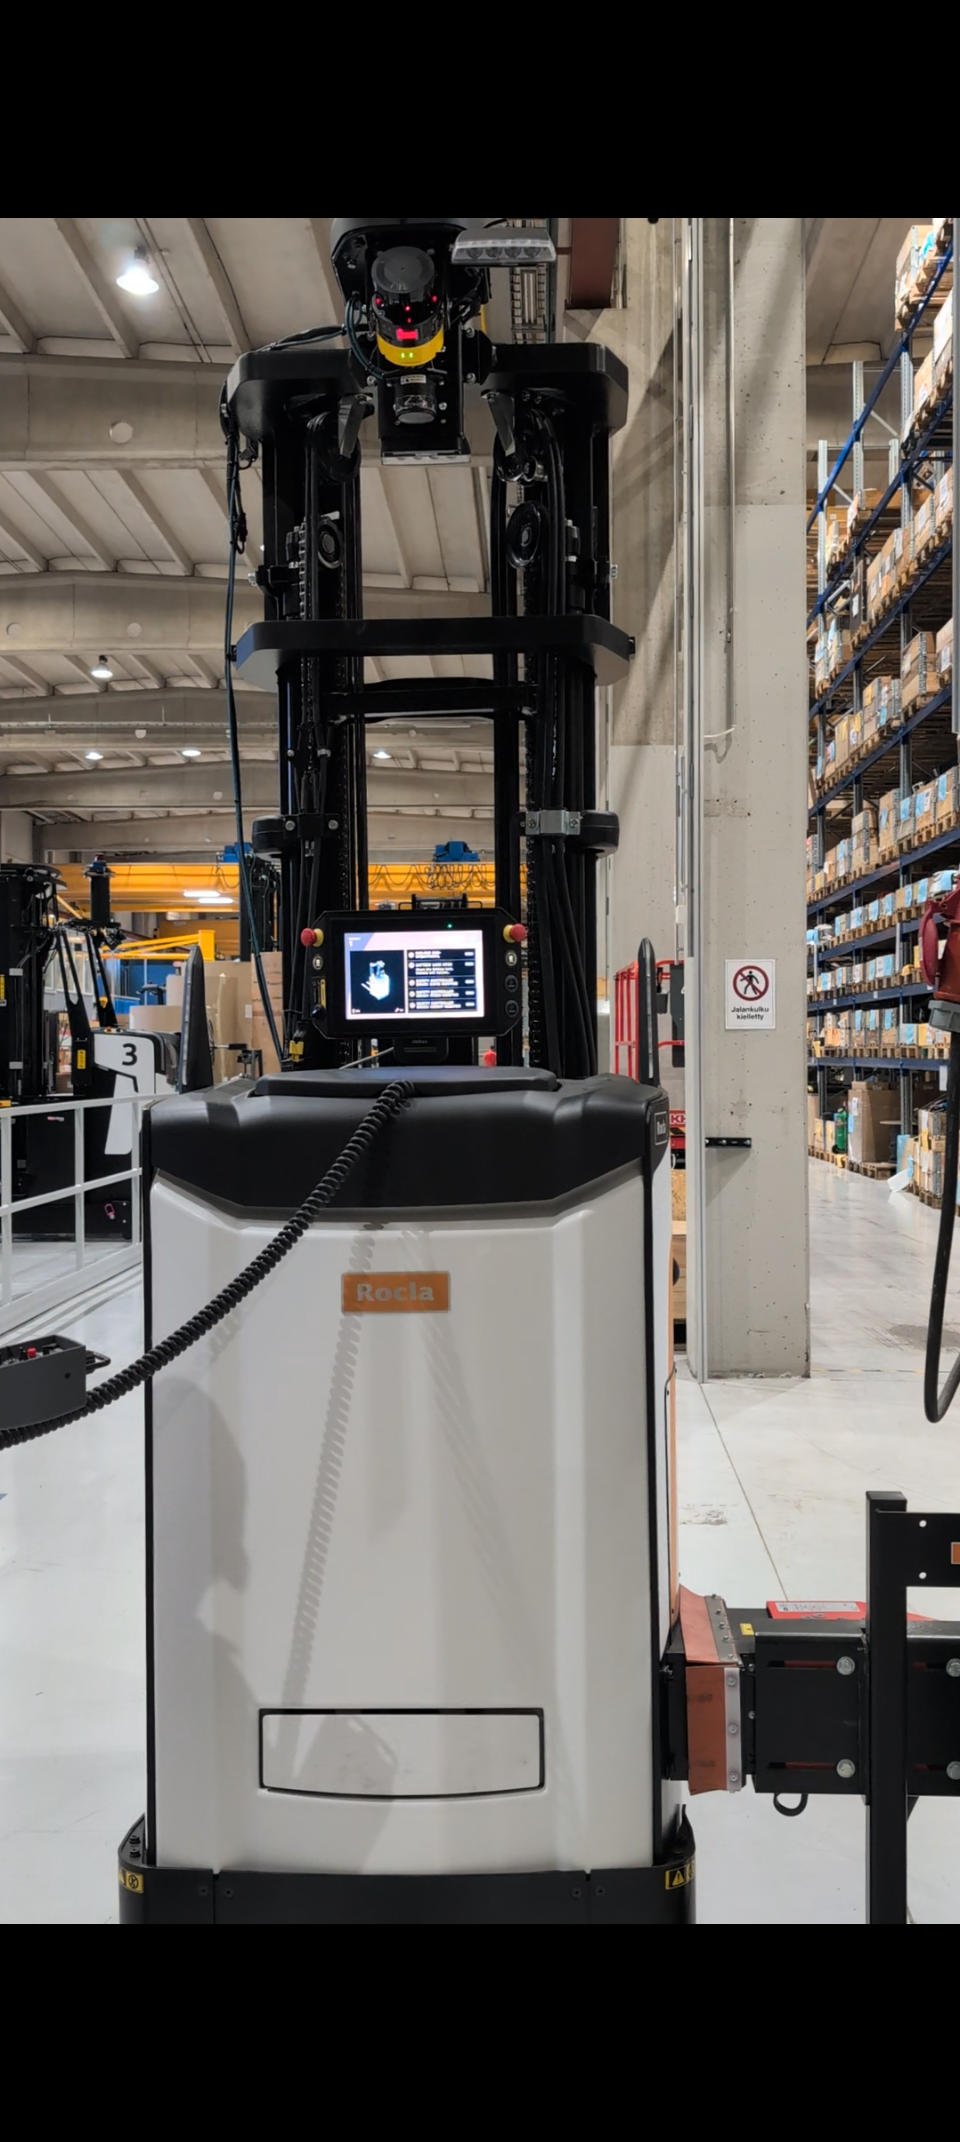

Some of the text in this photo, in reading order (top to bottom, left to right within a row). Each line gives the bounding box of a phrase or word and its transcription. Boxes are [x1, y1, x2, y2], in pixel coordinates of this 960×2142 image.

[737, 1013, 764, 1021] kielletty
[122, 1043, 138, 1066] 3
[357, 1281, 434, 1302] Rocla
